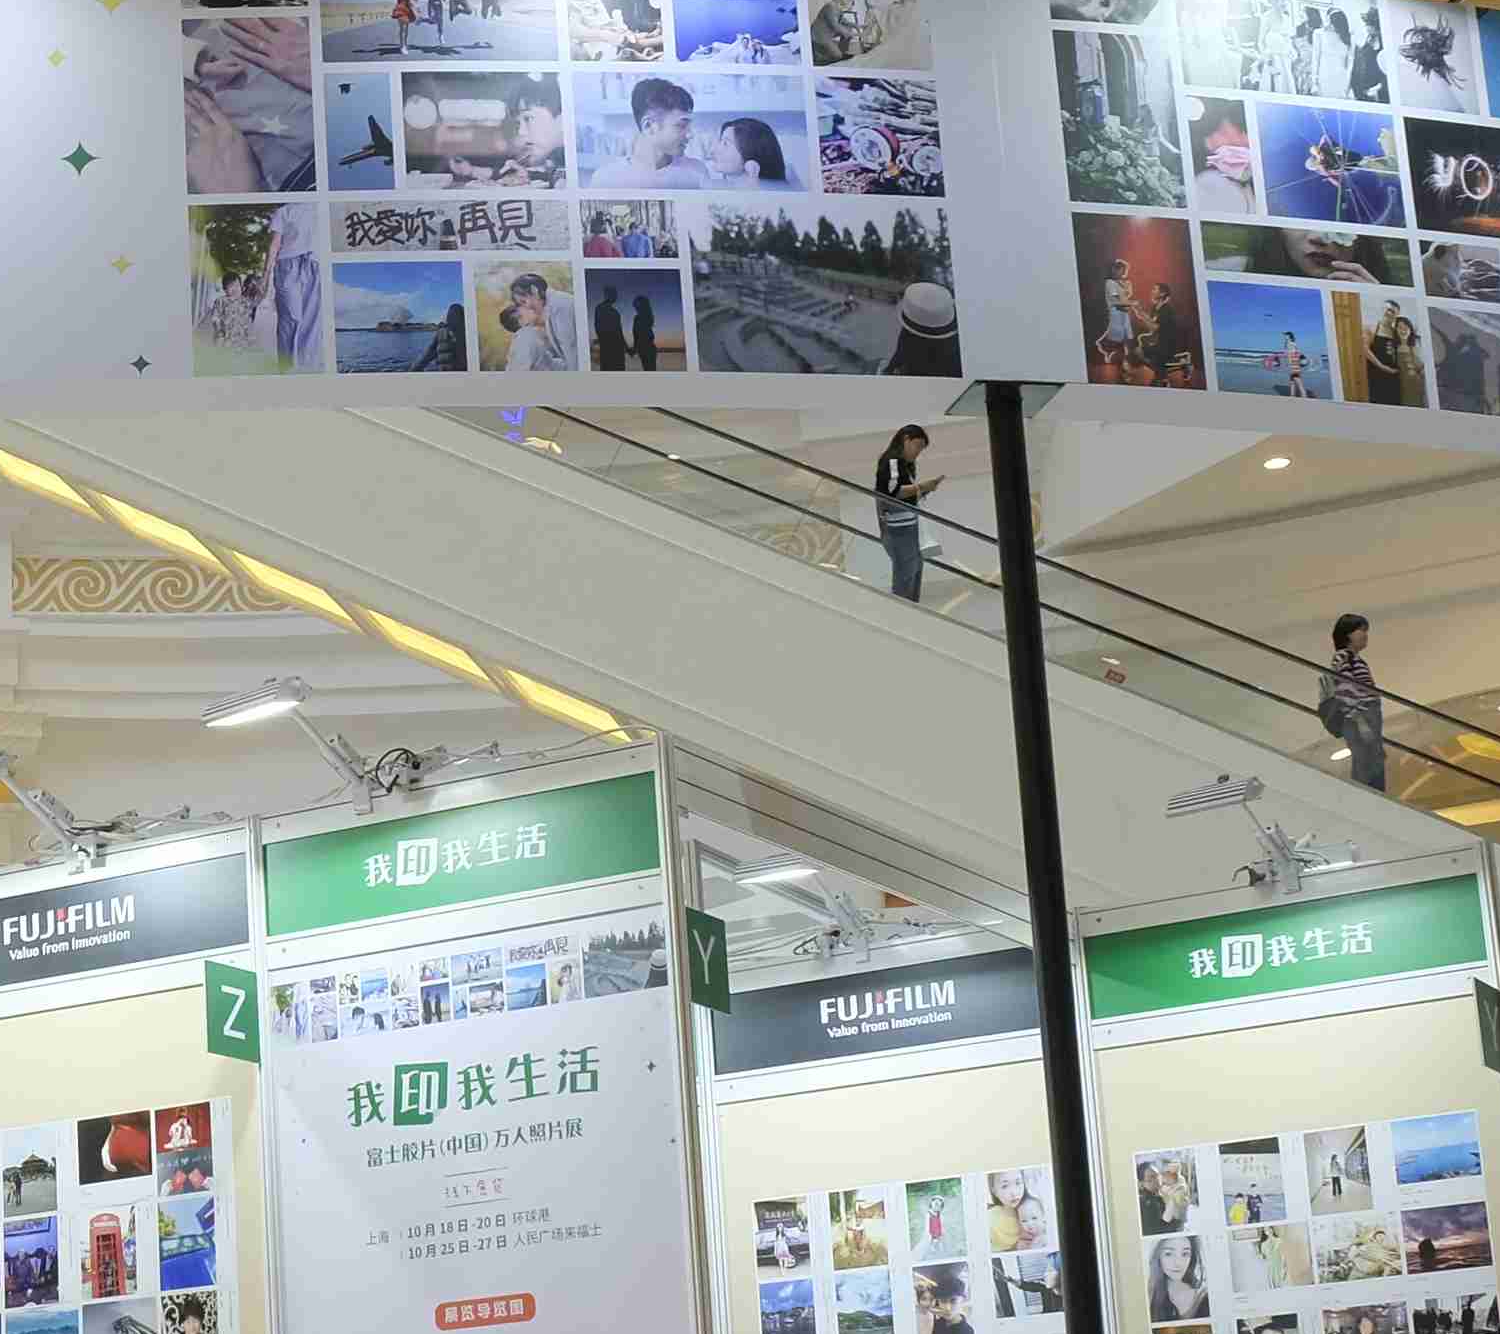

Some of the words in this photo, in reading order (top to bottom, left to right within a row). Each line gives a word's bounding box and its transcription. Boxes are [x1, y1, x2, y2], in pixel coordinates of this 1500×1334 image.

[362, 822, 549, 888] 我印我生活
[3, 894, 135, 946] FUJIFILM
[9, 943, 40, 961] Value
[41, 938, 70, 955] from
[72, 927, 131, 950] Innovation
[692, 929, 715, 985] Y
[1187, 921, 1375, 979] 我印我生活
[220, 984, 246, 1041] Z
[819, 980, 956, 1024] FUJIFILM
[827, 1024, 859, 1039] Value
[861, 1020, 889, 1034] from
[891, 1010, 952, 1030] Innovation
[346, 1045, 601, 1127] 我印我生活
